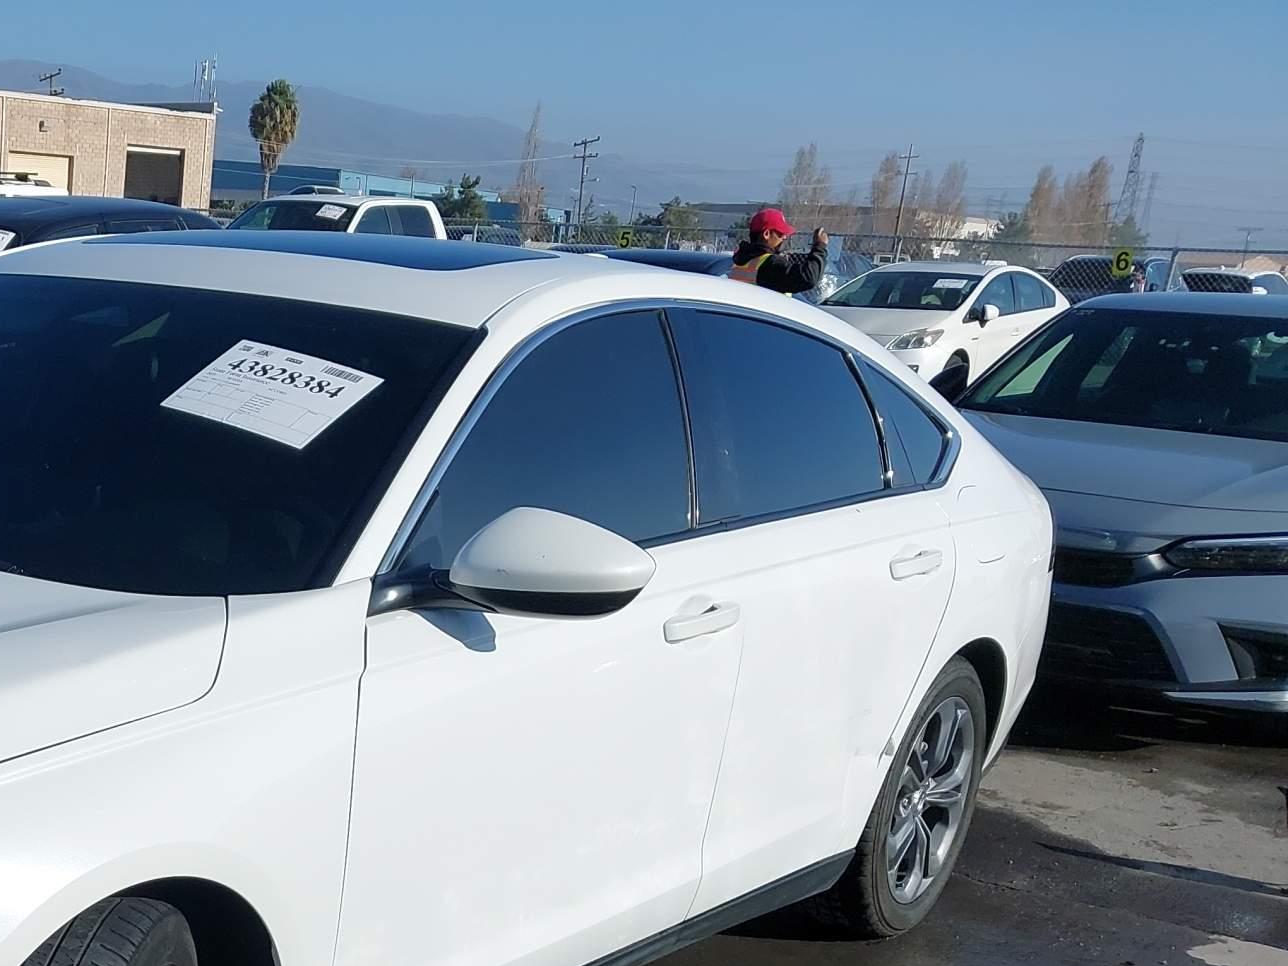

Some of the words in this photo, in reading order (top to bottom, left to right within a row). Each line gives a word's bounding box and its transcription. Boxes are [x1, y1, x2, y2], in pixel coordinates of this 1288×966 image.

[619, 231, 631, 248] 5
[1116, 251, 1130, 271] 6
[228, 358, 346, 398] 43828384
